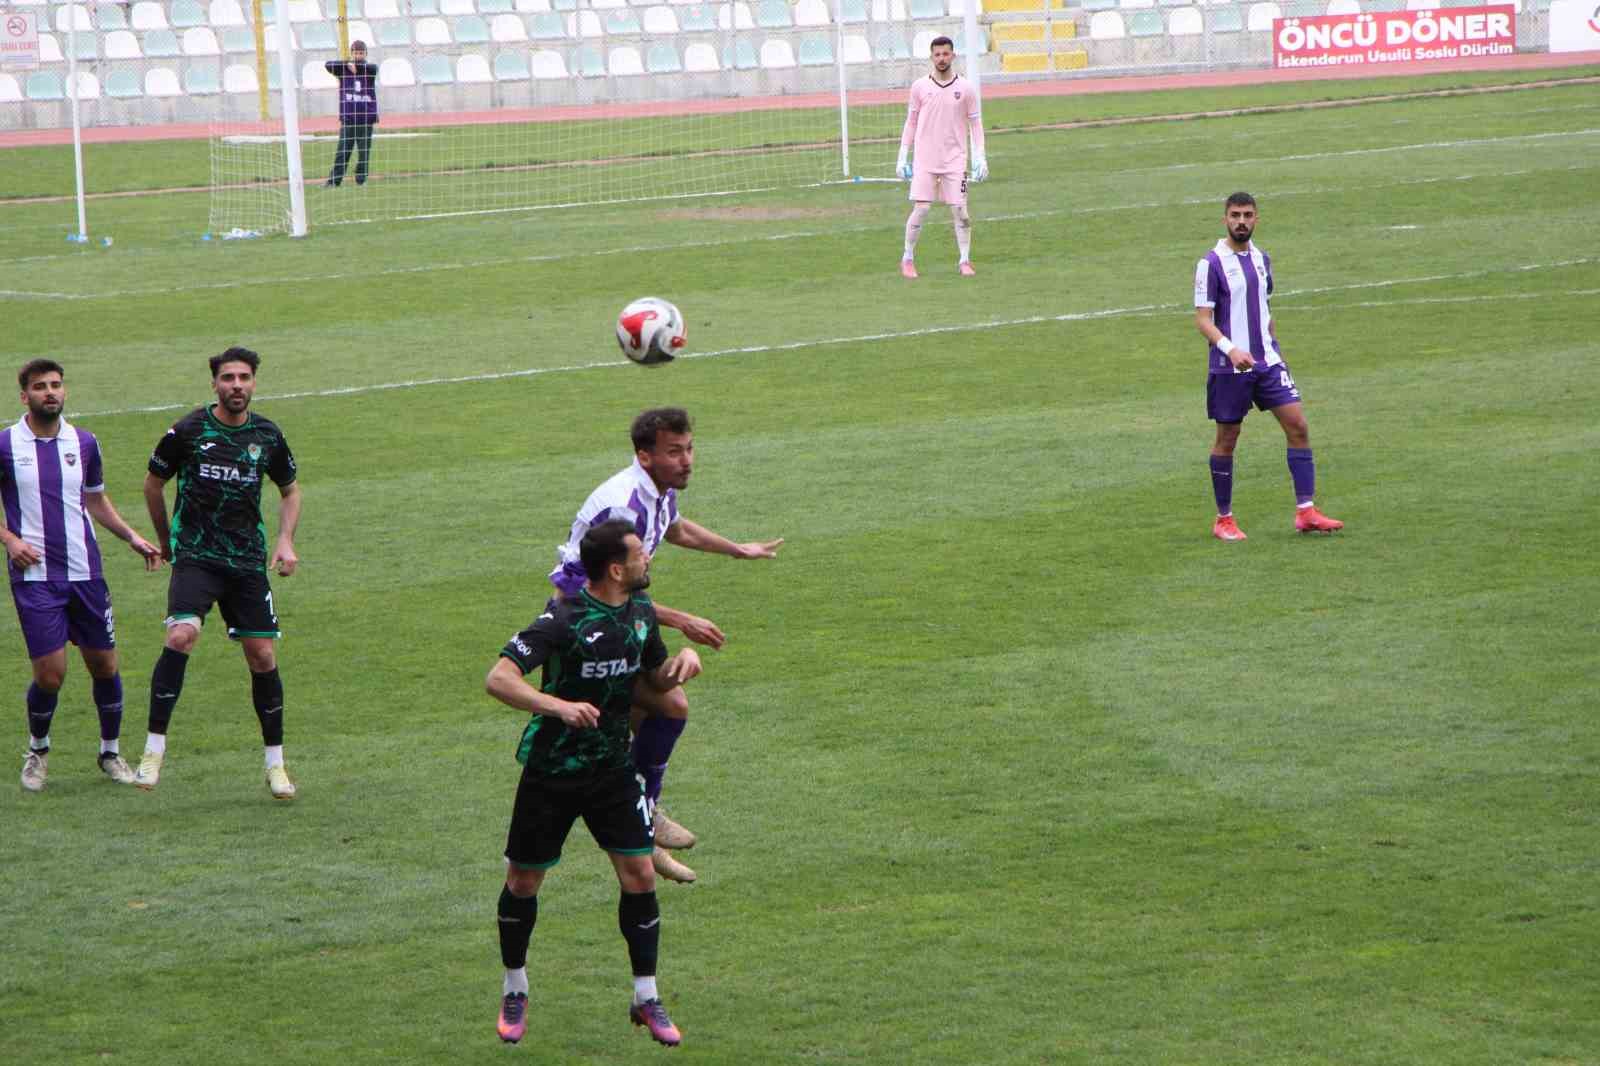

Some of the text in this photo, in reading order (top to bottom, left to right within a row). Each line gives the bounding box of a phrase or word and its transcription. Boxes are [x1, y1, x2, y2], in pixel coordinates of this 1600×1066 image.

[1278, 10, 1512, 51] ÖNCÜ DÖNER
[1278, 42, 1513, 68] İskenderun Usulü Soslu Dürüm
[199, 463, 241, 481] ESTA
[581, 658, 628, 679] ESTA
